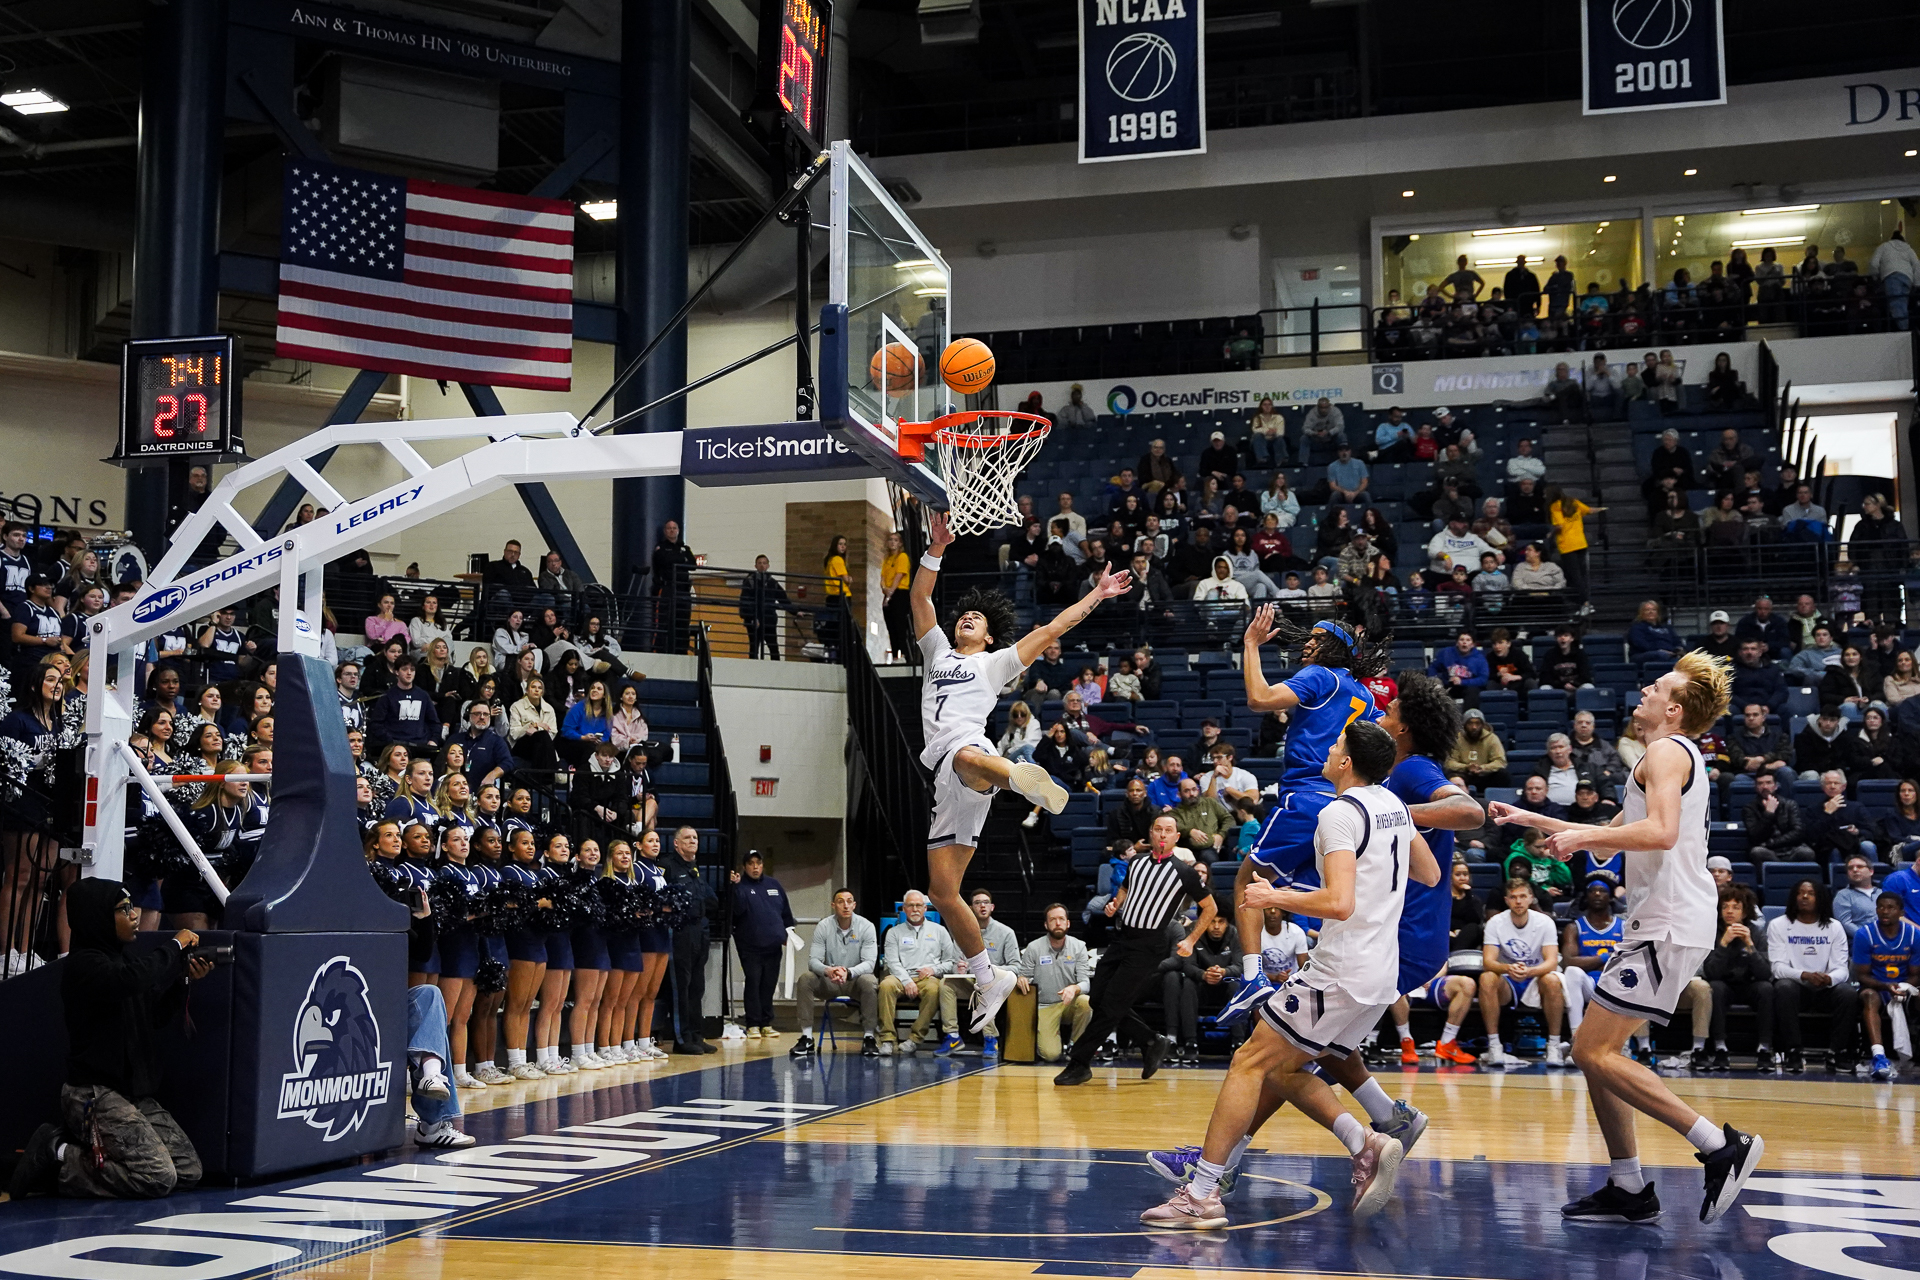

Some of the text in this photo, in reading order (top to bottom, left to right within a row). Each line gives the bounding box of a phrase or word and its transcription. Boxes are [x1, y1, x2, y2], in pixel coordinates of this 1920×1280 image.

[1095, 0, 1187, 26] NCAA
[333, 17, 347, 33] &
[421, 34, 451, 53] HN
[1615, 57, 1692, 93] 2001
[1108, 109, 1178, 144] 1996
[160, 356, 221, 387] 7:41
[962, 364, 995, 383] Wilson
[1379, 373, 1398, 393] Q
[1253, 390, 1291, 402] BANK
[1292, 387, 1343, 401] CENTER
[153, 393, 208, 437] 27
[140, 441, 214, 452] DAKTRONICS
[695, 434, 855, 461] TicketSmarte
[0, 491, 108, 526] ONS
[336, 484, 425, 535] LEGACY
[134, 545, 283, 620] SNA SPORTS
[927, 663, 976, 687] Hawks
[935, 693, 950, 722] 7
[1341, 696, 1367, 735] 7
[756, 780, 775, 796] EXIT
[1390, 834, 1400, 894] 1
[1582, 939, 1621, 947] HOFSTR
[1788, 935, 1815, 945] NOTHING
[1885, 963, 1900, 978] 5
[283, 1070, 388, 1109] MONMOUTH
